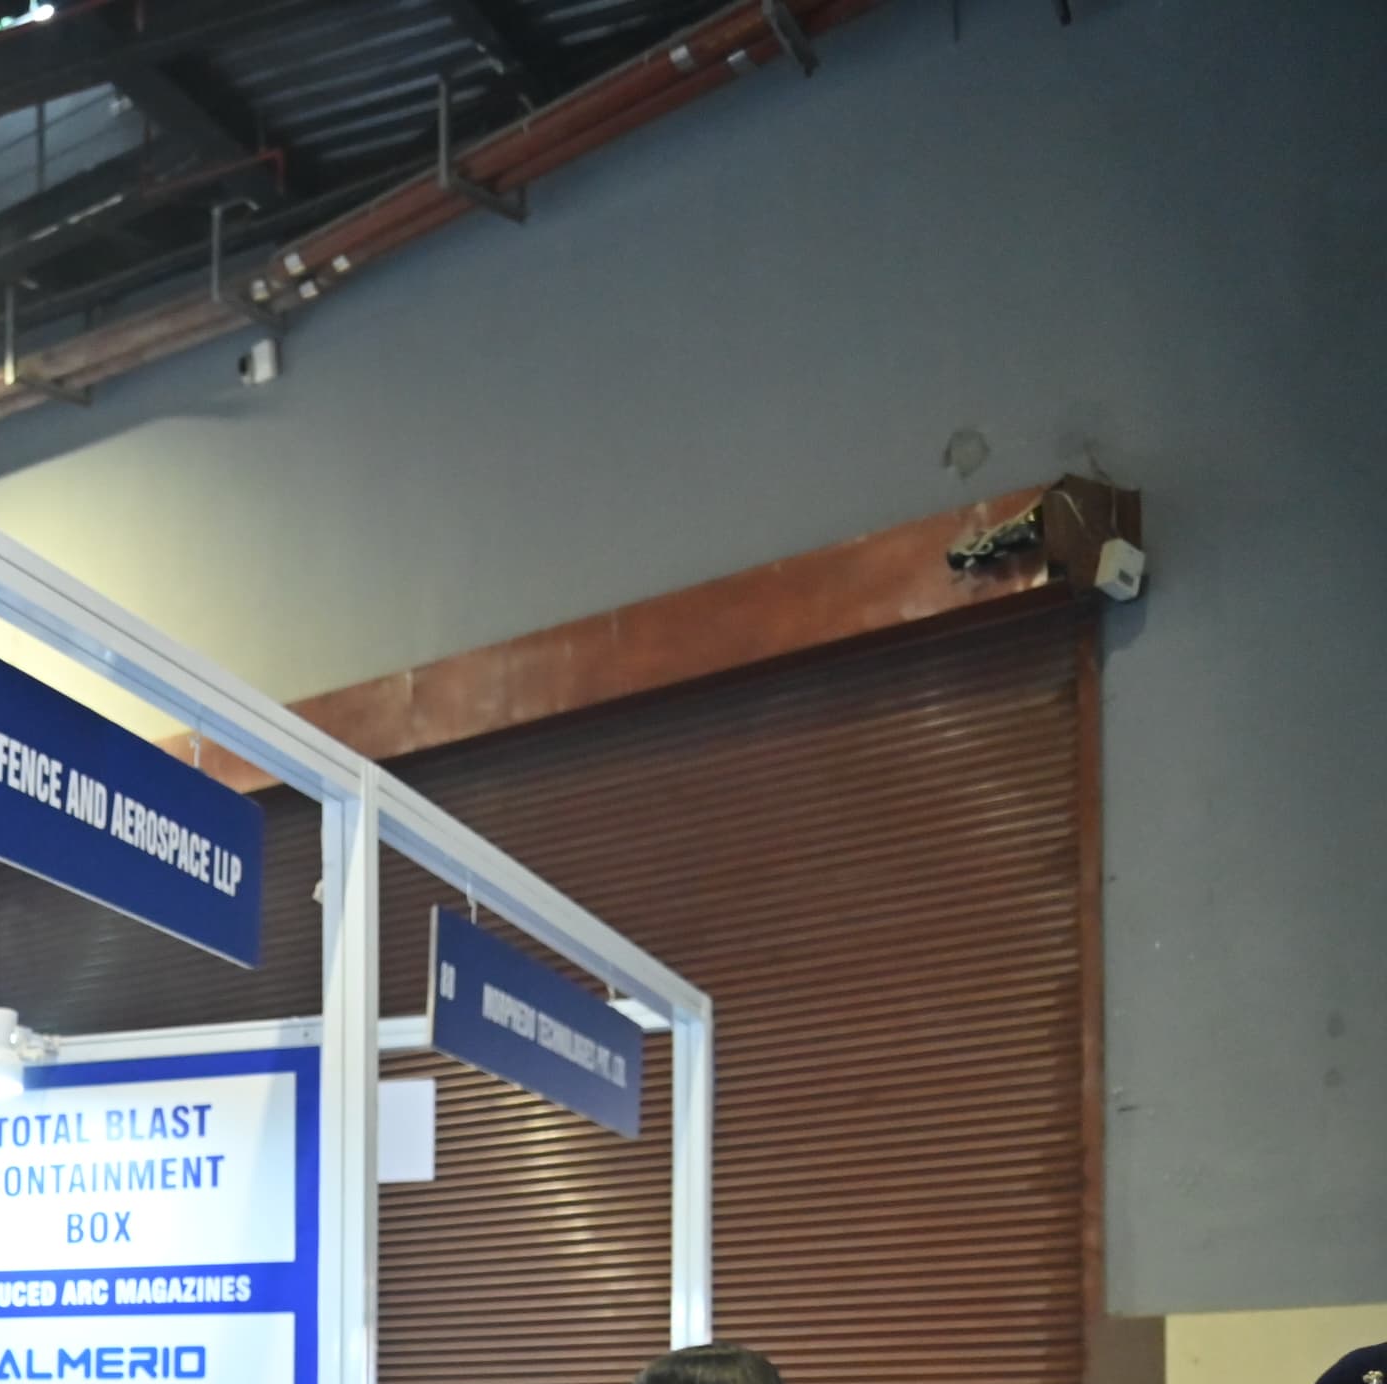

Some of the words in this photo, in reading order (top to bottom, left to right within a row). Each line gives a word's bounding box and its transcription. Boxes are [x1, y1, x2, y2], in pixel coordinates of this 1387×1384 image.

[66, 769, 107, 830] AND
[111, 792, 210, 884] AEROSPACE
[213, 845, 241, 898] LLP
[105, 1104, 211, 1142] BLAST
[67, 1211, 131, 1244] BOX
[61, 1279, 109, 1306] ARC
[115, 1275, 251, 1304] MAGAZINES
